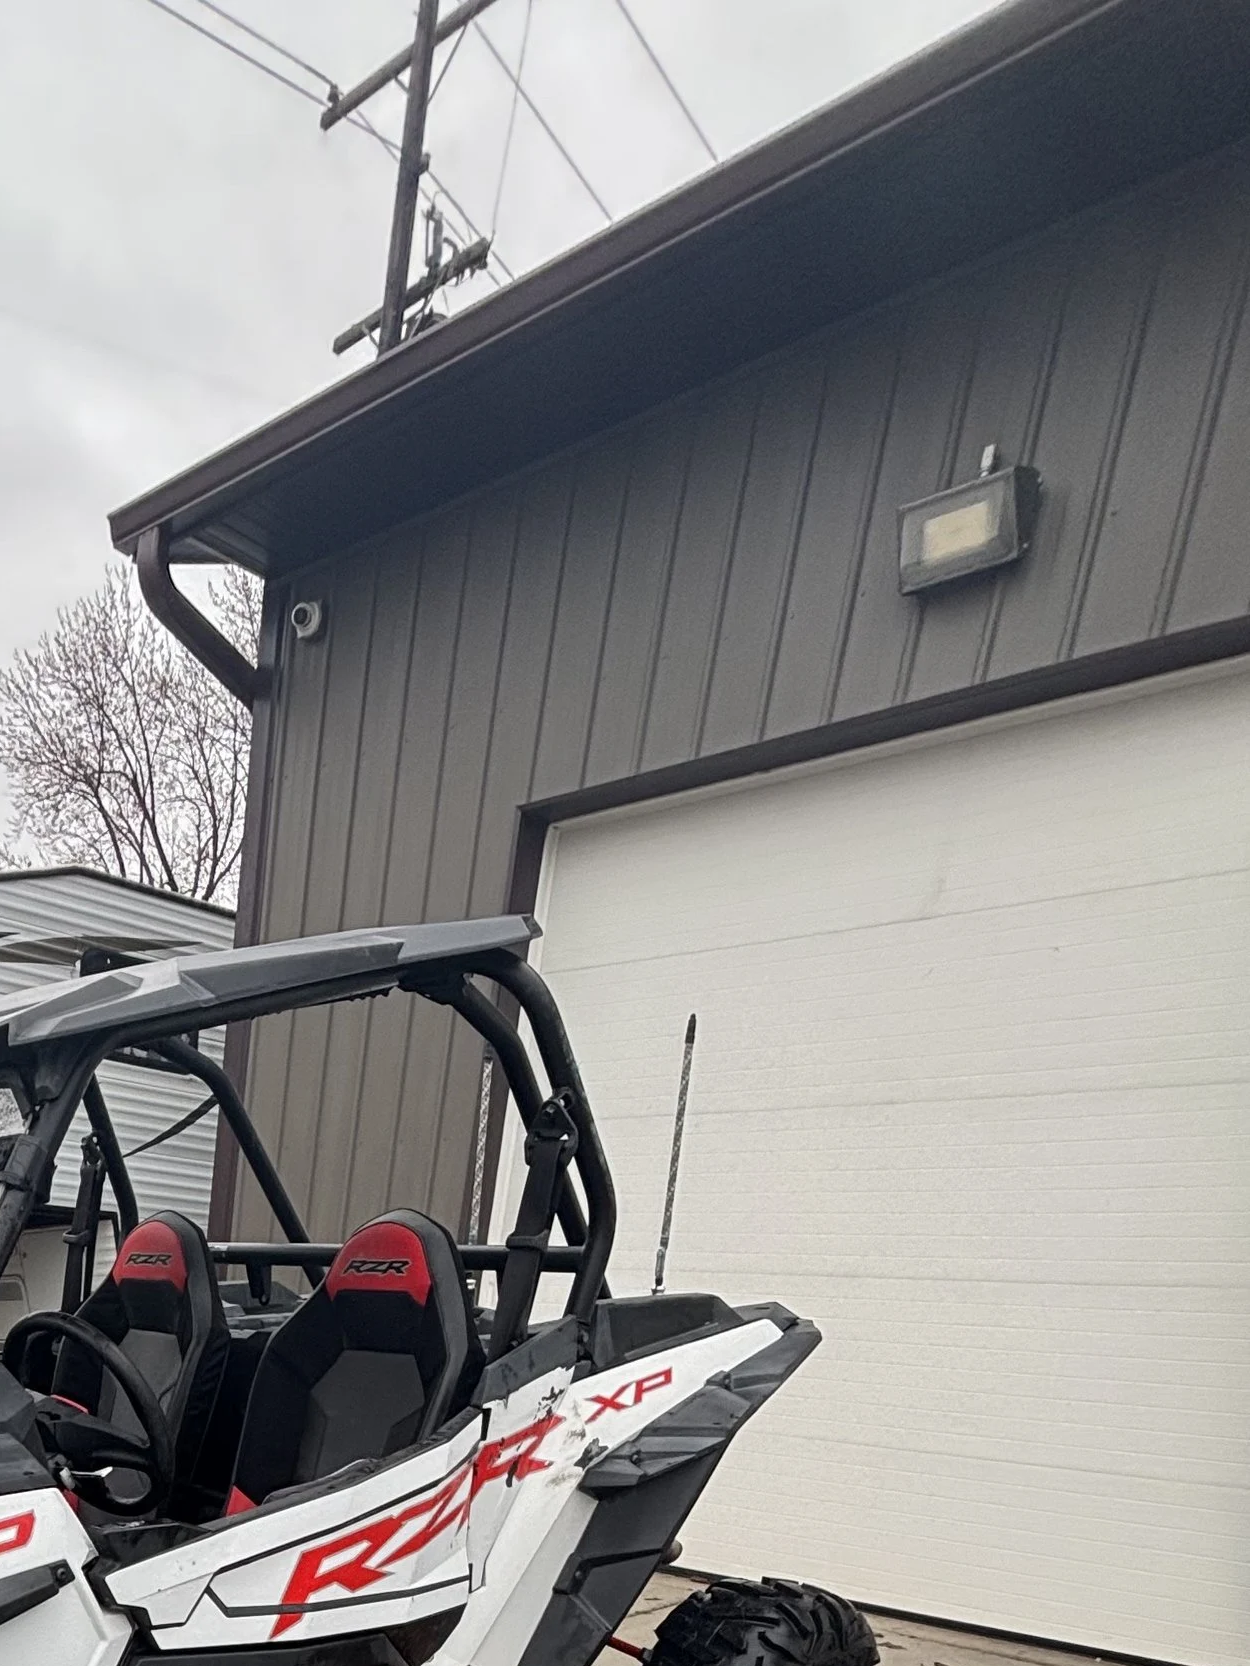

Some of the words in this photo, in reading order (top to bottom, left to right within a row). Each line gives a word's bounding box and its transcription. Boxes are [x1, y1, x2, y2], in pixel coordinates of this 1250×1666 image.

[125, 1252, 171, 1266] RZR
[343, 1260, 411, 1275] RZR
[268, 1413, 566, 1641] RZR
[583, 1366, 673, 1424] XP
